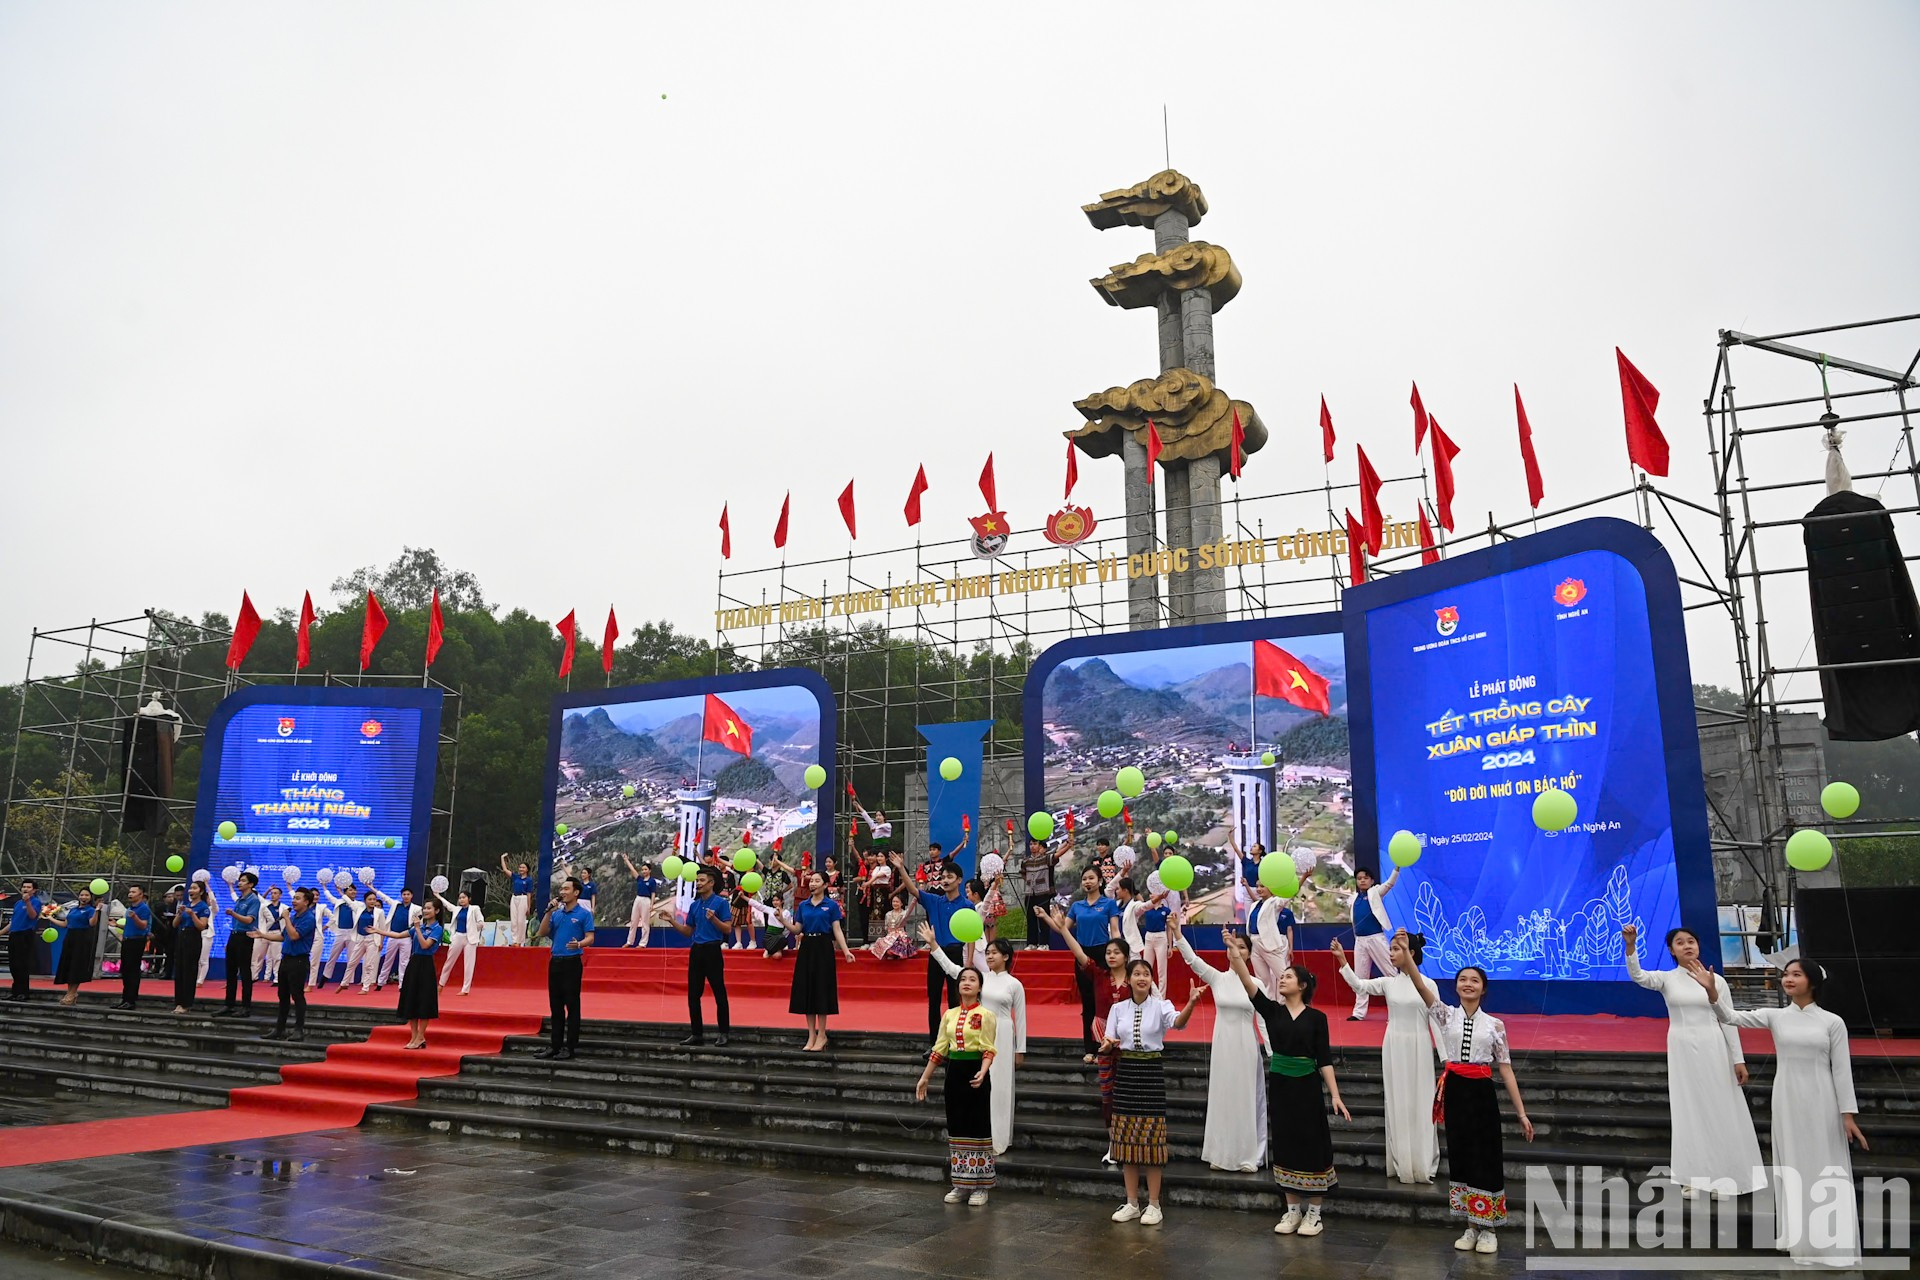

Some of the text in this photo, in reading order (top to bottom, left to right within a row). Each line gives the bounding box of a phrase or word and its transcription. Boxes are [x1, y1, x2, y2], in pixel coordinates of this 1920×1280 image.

[715, 605, 772, 631] THANH
[830, 589, 882, 617] XUNG
[890, 580, 941, 608] KÍCH,
[944, 573, 991, 601] TÌNH
[999, 559, 1087, 595] NGUYỆN
[1096, 552, 1118, 582] VÌ
[1127, 545, 1189, 580] CUỘC
[1198, 534, 1265, 569] SỐNG
[1276, 528, 1348, 565] CỘNG
[1469, 675, 1536, 698] LỄ PHÁT ĐỘNG
[1426, 694, 1592, 737] TẾT TRỒNG CÂY
[1426, 717, 1597, 760] XUÂN GIÁP THÌN
[1481, 750, 1536, 770] 2024
[281, 783, 345, 800] THÁNG
[1469, 784, 1487, 801] ĐỜI
[1490, 779, 1512, 798] NHỚ
[1515, 781, 1531, 796] ƠN
[1534, 775, 1557, 793] BÁC
[251, 801, 371, 818] THANH NIÊN
[287, 817, 330, 829] 2024
[1583, 822, 1607, 833] Nghệ
[1608, 821, 1621, 830] An
[1430, 832, 1493, 846] Ngày 25/02/2024
